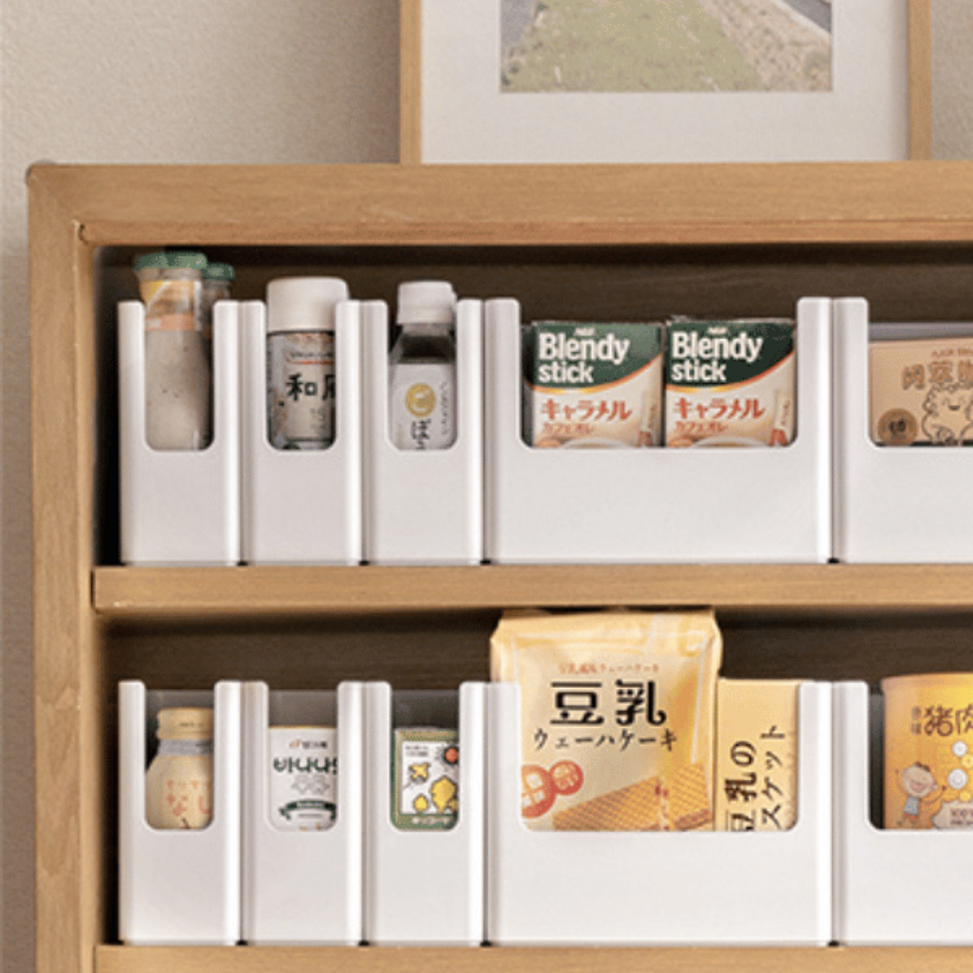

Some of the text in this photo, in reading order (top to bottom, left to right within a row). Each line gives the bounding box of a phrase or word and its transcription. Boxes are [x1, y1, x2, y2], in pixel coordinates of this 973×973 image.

[538, 332, 630, 364] Blendy
[671, 331, 763, 363] Blendy
[538, 361, 594, 384] stick
[671, 359, 727, 382] stick
[541, 398, 633, 421] キャラメル
[674, 397, 765, 420] キャラメル
[550, 679, 667, 726] 豆乳
[534, 728, 677, 751] ウェーハケーキ
